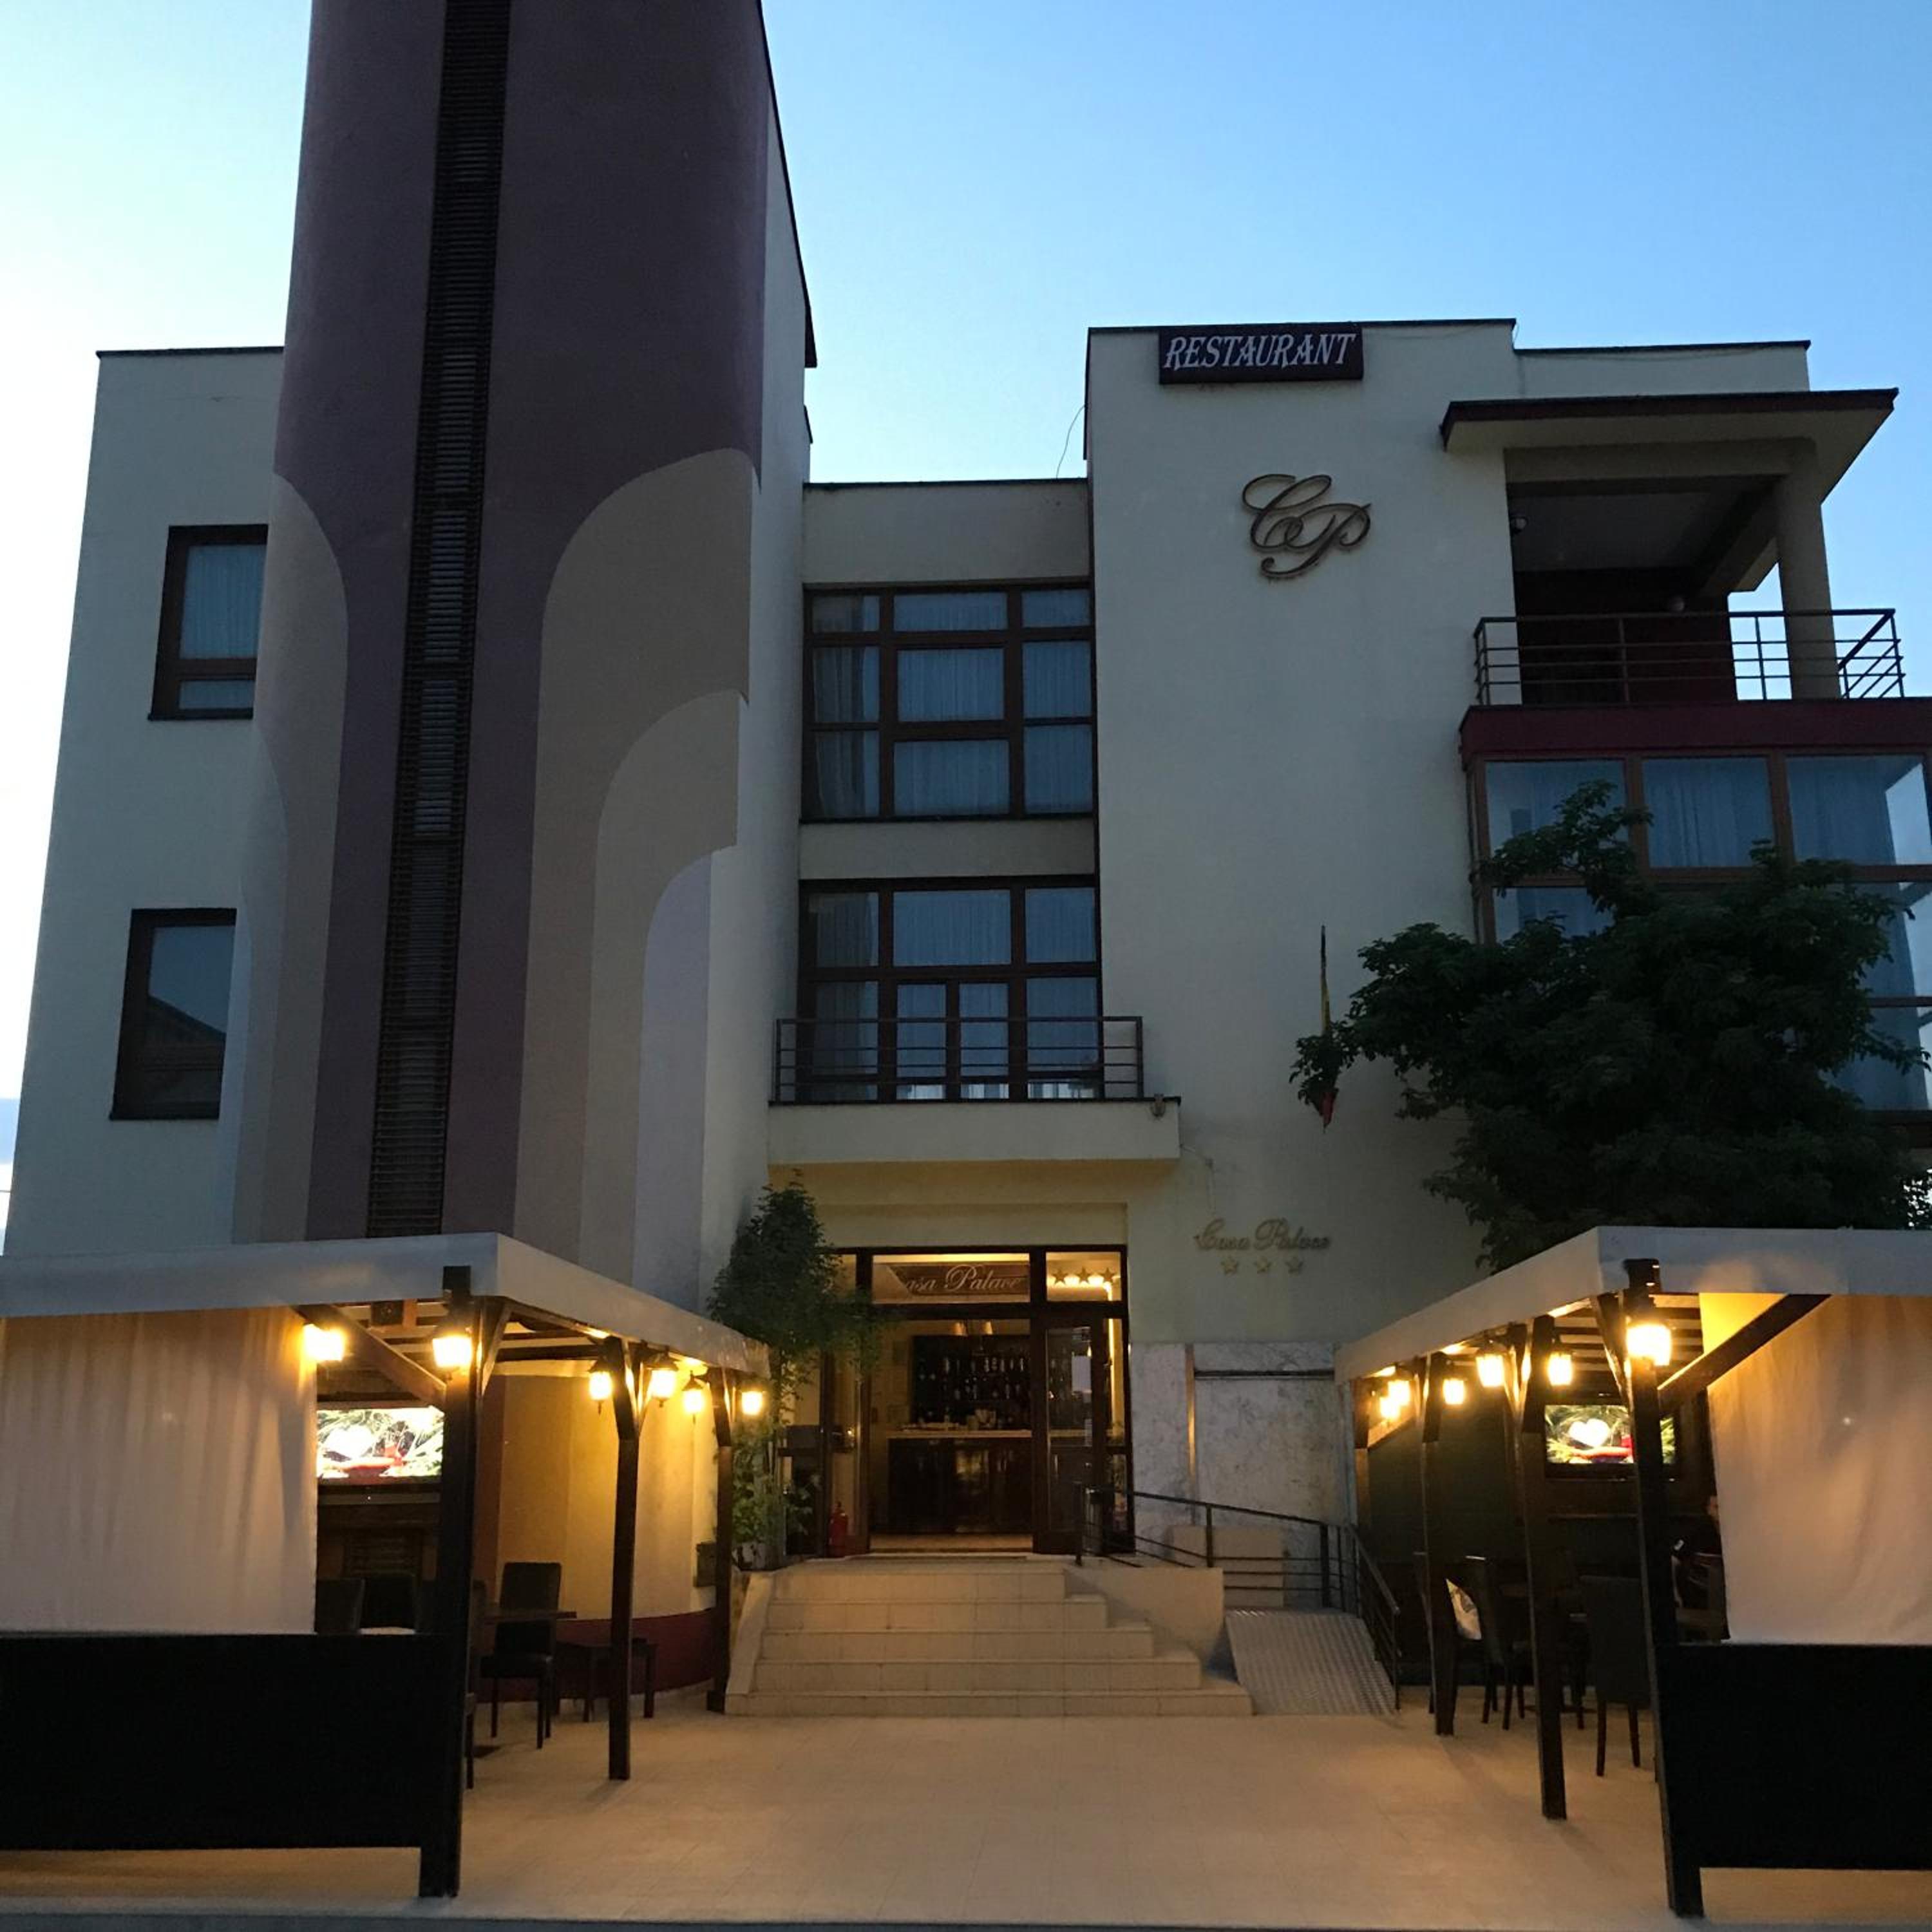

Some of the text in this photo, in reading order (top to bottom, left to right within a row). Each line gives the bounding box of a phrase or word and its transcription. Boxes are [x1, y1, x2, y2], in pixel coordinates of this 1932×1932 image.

[1162, 334, 1356, 370] RESTAURANT
[1193, 1218, 1250, 1250] Casa
[900, 1264, 1021, 1293] asa Palace
